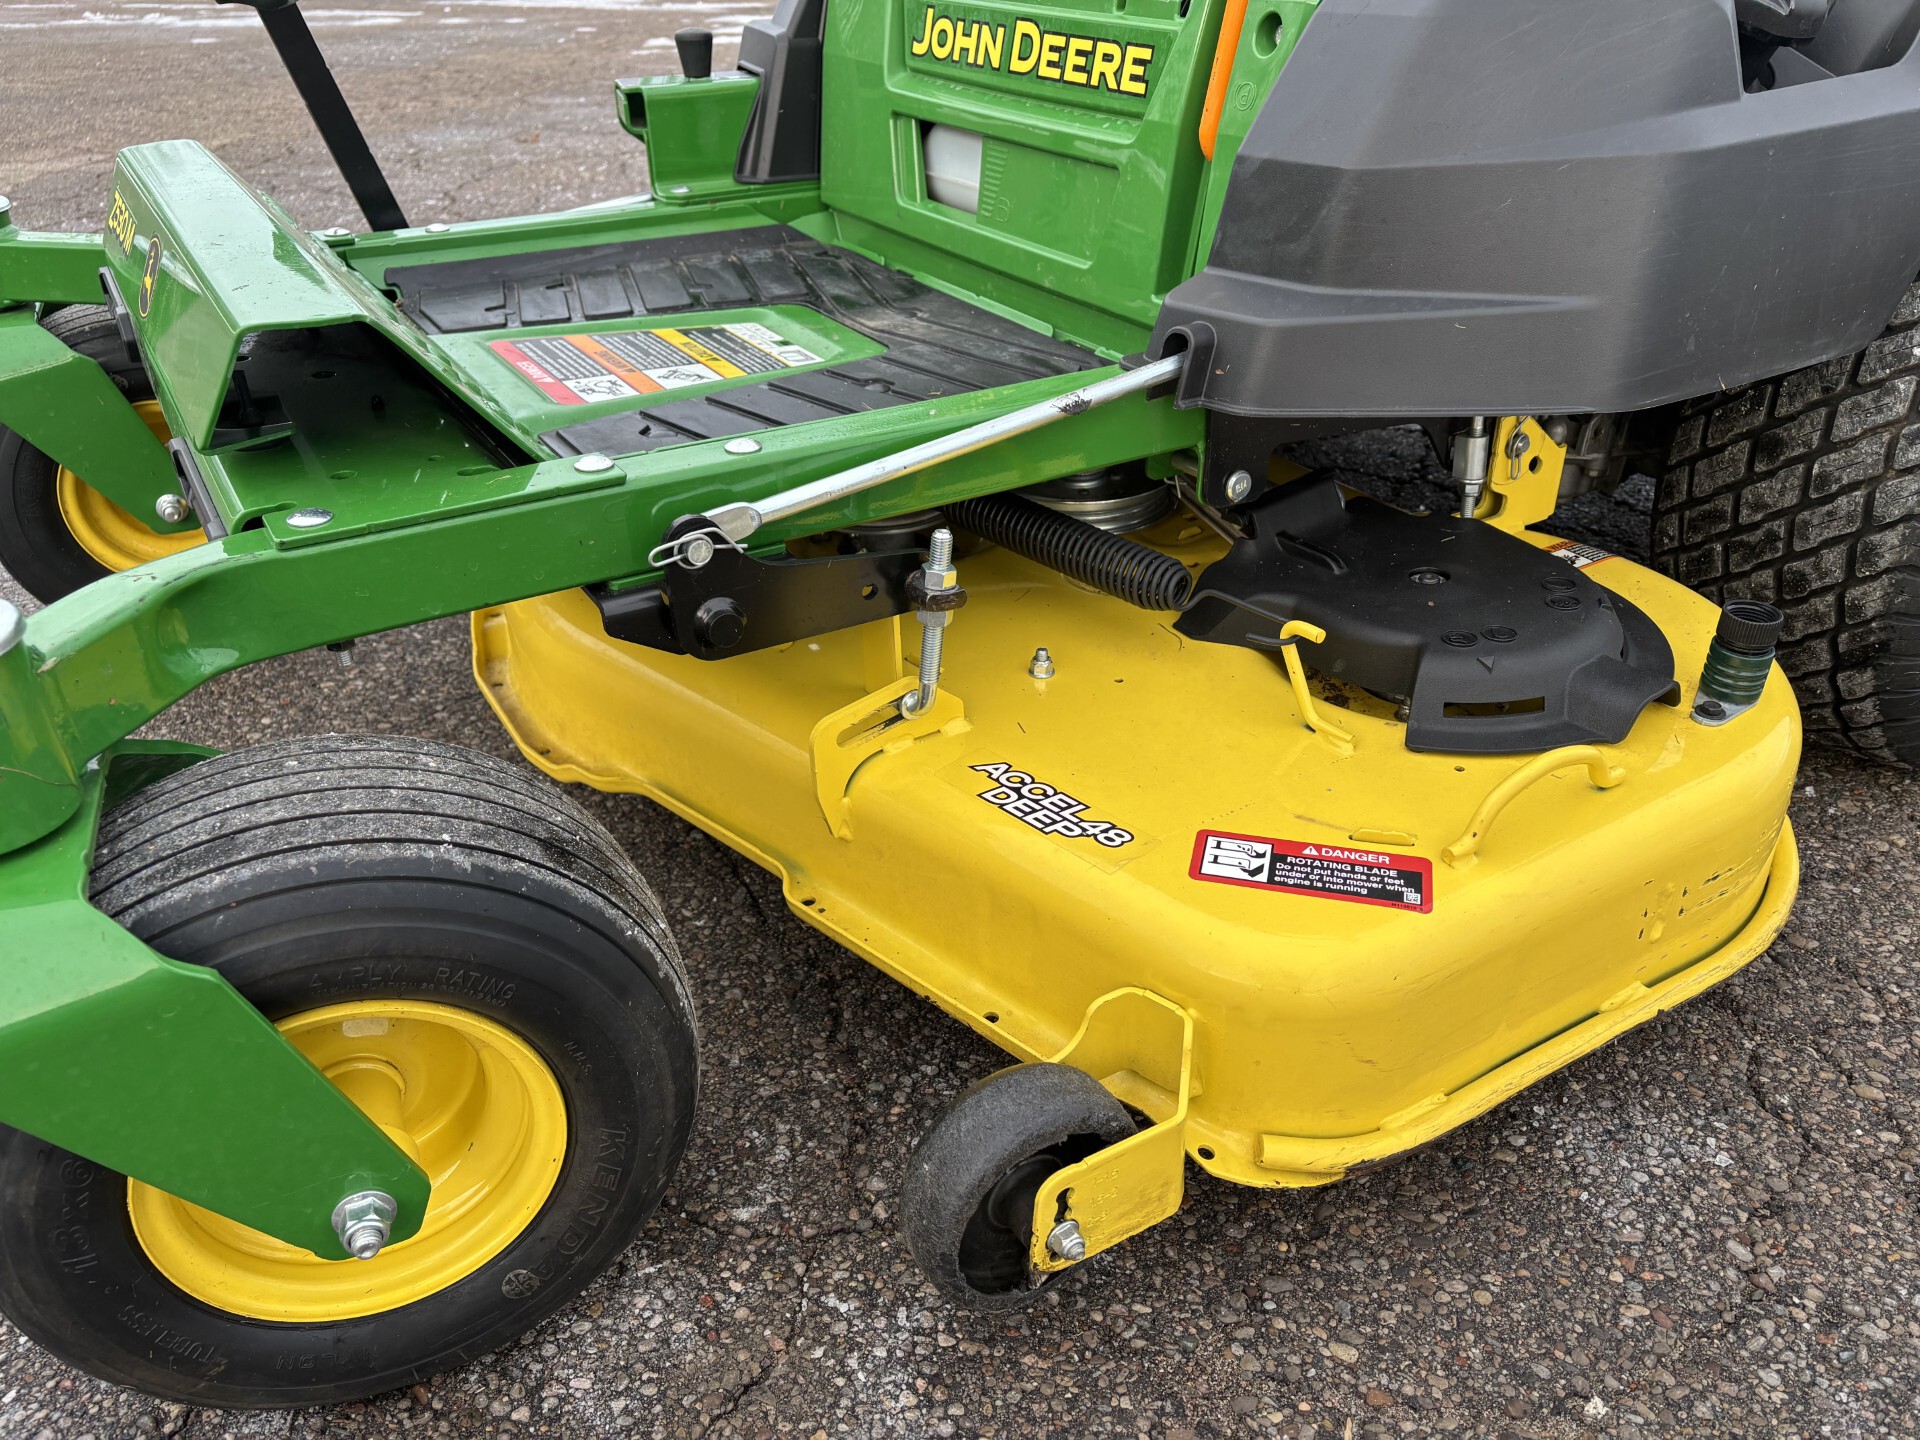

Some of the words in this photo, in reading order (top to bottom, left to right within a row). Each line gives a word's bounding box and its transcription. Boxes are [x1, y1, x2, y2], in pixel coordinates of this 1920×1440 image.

[911, 5, 1006, 72] JOHN
[1008, 17, 1155, 97] DEERE
[108, 189, 136, 259] Z530M
[968, 762, 1091, 824] ACCEL
[976, 786, 1083, 838] DEEP
[1078, 820, 1135, 848] 48
[1276, 862, 1291, 870] Do
[1293, 865, 1312, 873] not
[1313, 867, 1332, 876] put
[1333, 869, 1367, 880] hands
[1384, 877, 1405, 886] feet
[1286, 855, 1352, 871] ROTATING
[1354, 865, 1398, 878] BLADE
[1321, 847, 1391, 864] DANGER
[1274, 875, 1311, 886] engine
[1313, 880, 1323, 888] is
[1325, 882, 1369, 895] running
[1275, 870, 1307, 879] under
[1323, 875, 1344, 884] into
[1346, 879, 1384, 889] mower
[1385, 884, 1416, 894] when
[434, 966, 518, 1000] RATING
[526, 1127, 628, 1281] KENDA
[117, 1303, 215, 1363] TUBELESS
